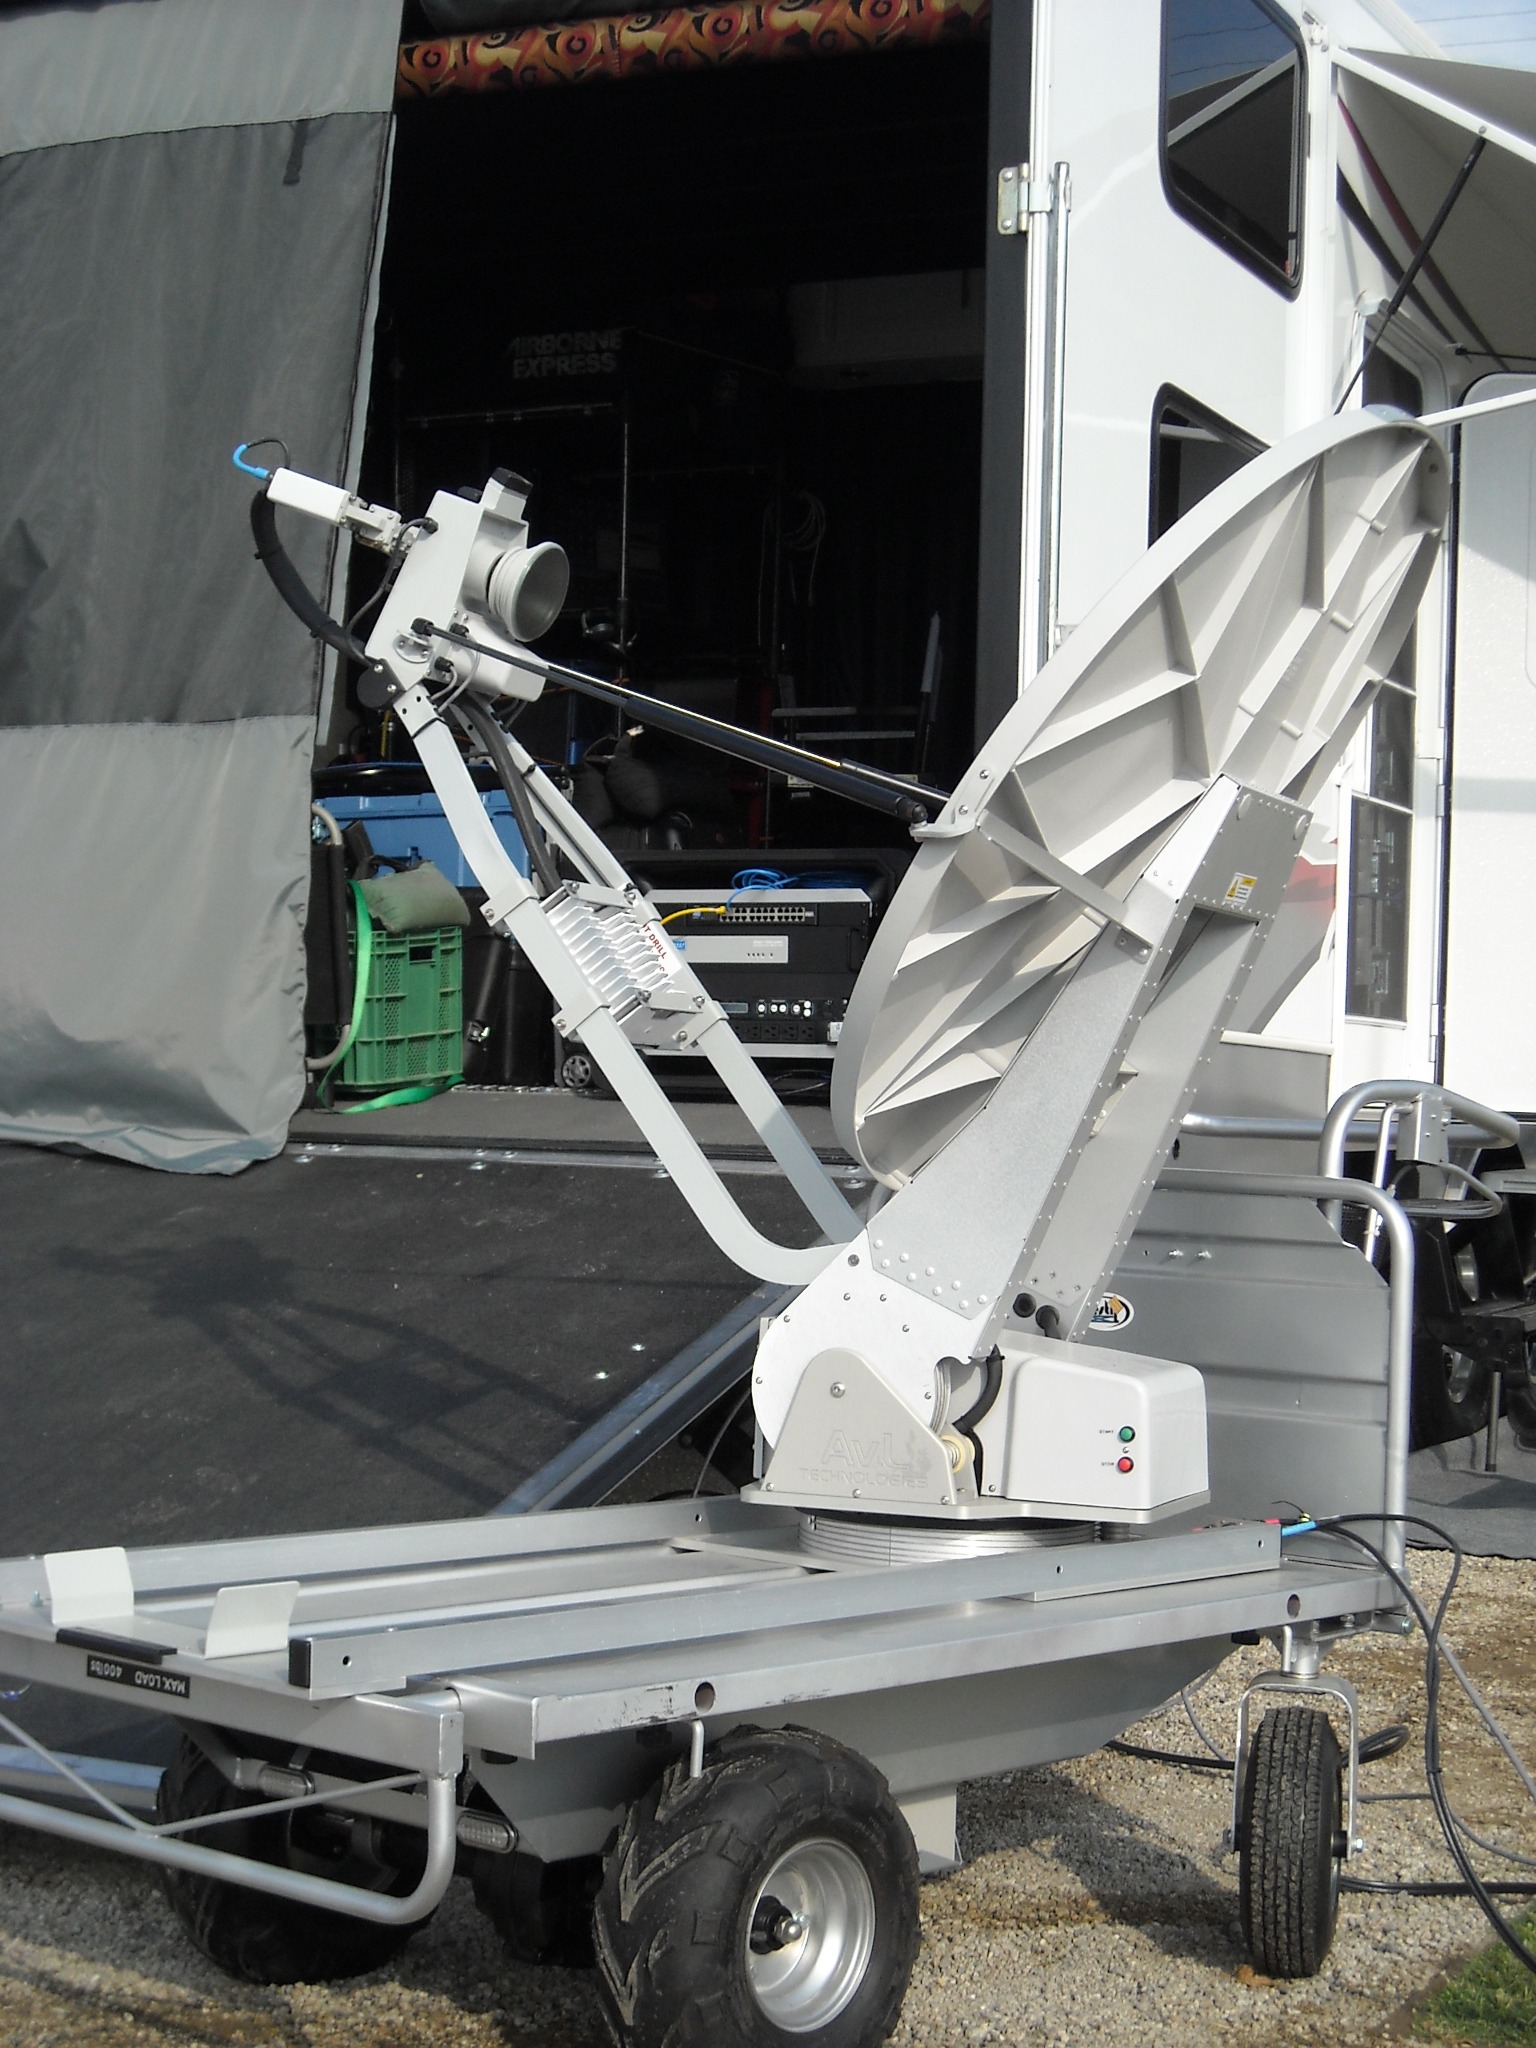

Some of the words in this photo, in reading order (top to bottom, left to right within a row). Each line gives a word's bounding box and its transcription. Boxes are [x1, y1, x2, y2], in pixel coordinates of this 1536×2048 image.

[504, 330, 623, 358] AIRBORNE
[512, 352, 618, 379] EXPRESS
[648, 933, 668, 960] DRILL
[820, 1429, 910, 1471] AvL
[798, 1467, 929, 1488] TECHNOLOGIES
[134, 1670, 162, 1688] LOAD
